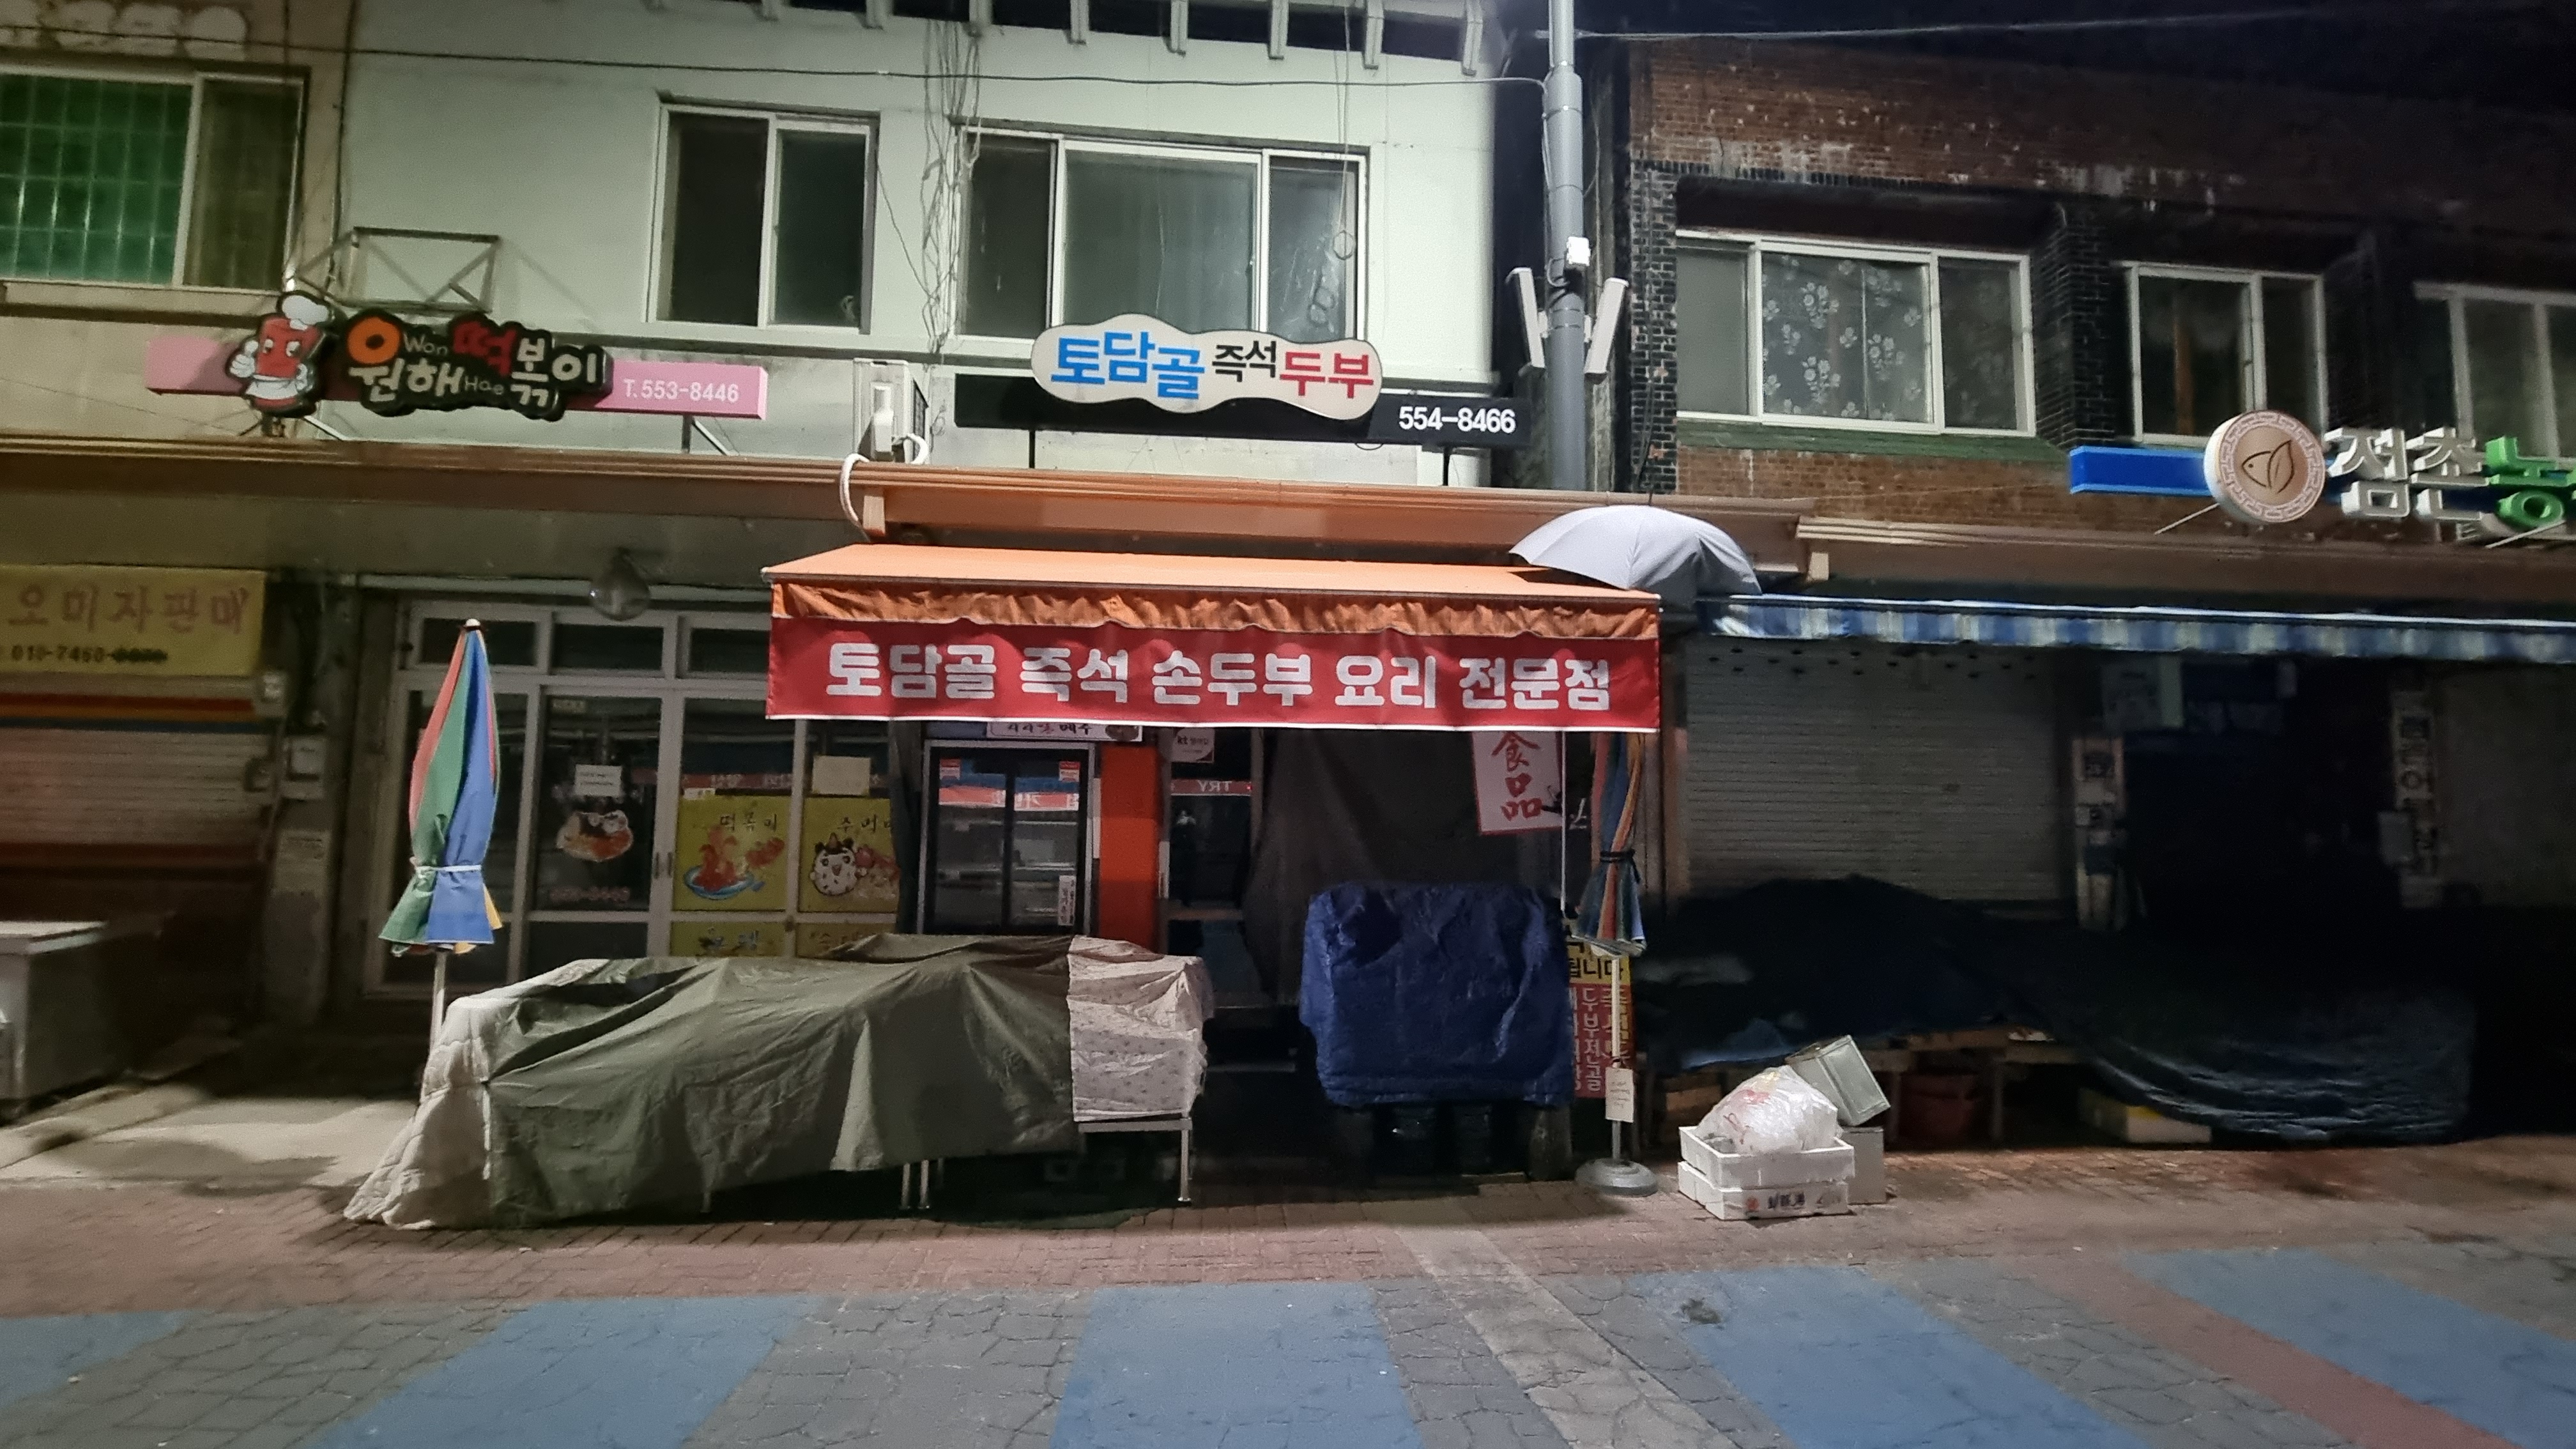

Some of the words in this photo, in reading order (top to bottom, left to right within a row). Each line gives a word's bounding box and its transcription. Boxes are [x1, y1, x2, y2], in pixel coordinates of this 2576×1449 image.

[403, 333, 447, 354] Won
[452, 319, 597, 408] 떡볶이
[1051, 331, 1206, 401] 토담골
[1211, 339, 1278, 382] 즉석
[1279, 349, 1374, 399] 두부
[464, 374, 504, 395] Hae
[1398, 405, 1517, 434] 554-8466
[825, 642, 997, 700] 토담골
[1020, 647, 1129, 703] 즉석
[1151, 649, 1314, 707] 손두부
[1334, 654, 1437, 709] 요리
[1459, 656, 1611, 712] 전문점
